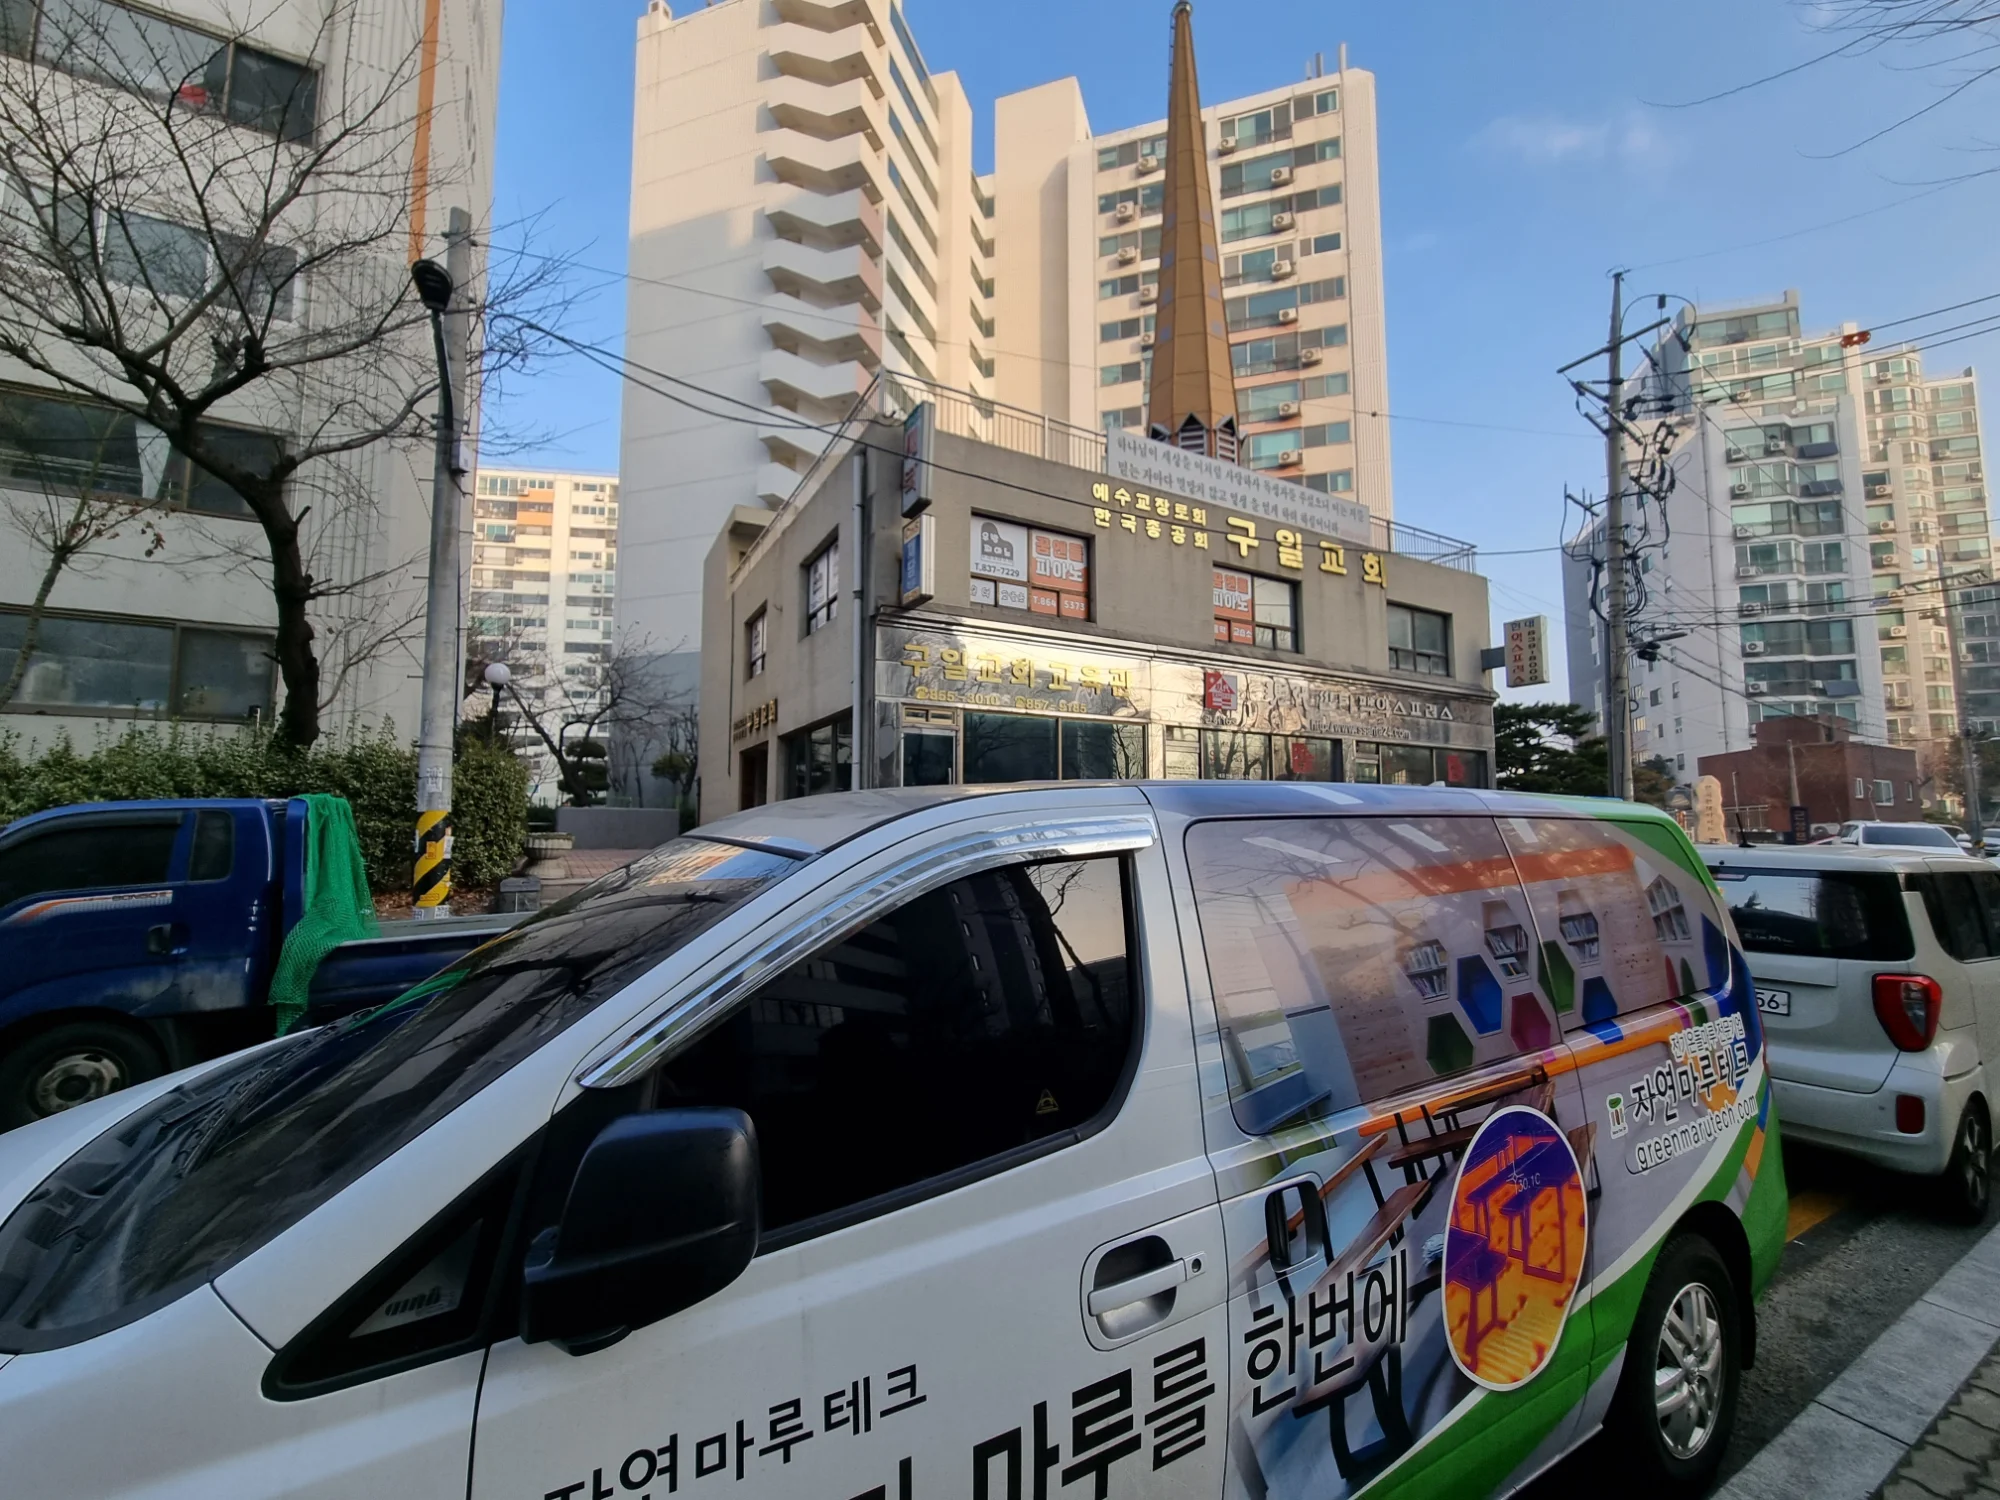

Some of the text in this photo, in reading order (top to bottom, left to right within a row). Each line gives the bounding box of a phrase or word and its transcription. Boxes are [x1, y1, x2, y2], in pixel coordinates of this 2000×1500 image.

[1092, 483, 1206, 526] 예수교장로회
[1036, 558, 1083, 582] 피아노
[1226, 516, 1388, 588] 구일교회
[1213, 590, 1249, 612] 피아노
[901, 644, 1133, 697] 구일교회 교육관
[1631, 1045, 1749, 1122] 자연마루테크
[1636, 1094, 1757, 1170] greenmarutech.com
[1244, 1249, 1408, 1418] 한번에
[972, 1336, 1216, 1500] 마루를
